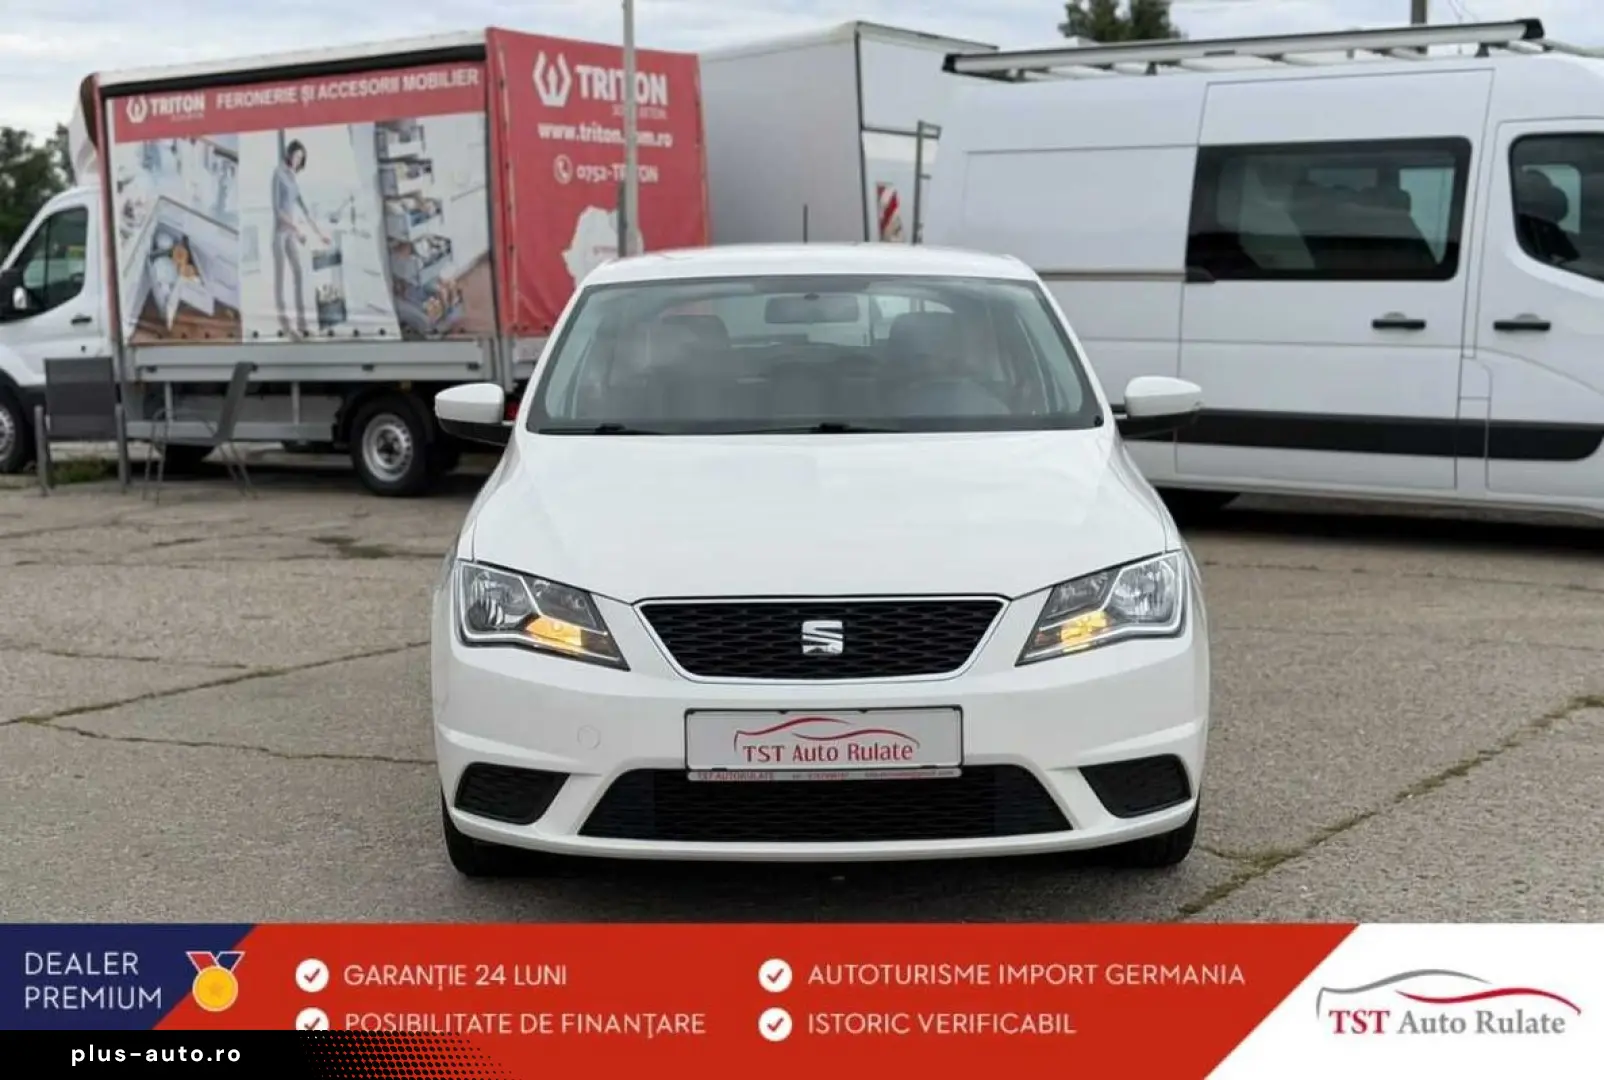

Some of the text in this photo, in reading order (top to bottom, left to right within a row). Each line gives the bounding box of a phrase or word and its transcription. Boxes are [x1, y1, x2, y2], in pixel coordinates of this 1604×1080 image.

[151, 93, 205, 116] TRITON
[216, 87, 298, 109] FERONERIE
[317, 75, 399, 100] ACCESORII
[402, 69, 479, 91] MOBILIER
[743, 741, 914, 763] TST Auto Rulate
